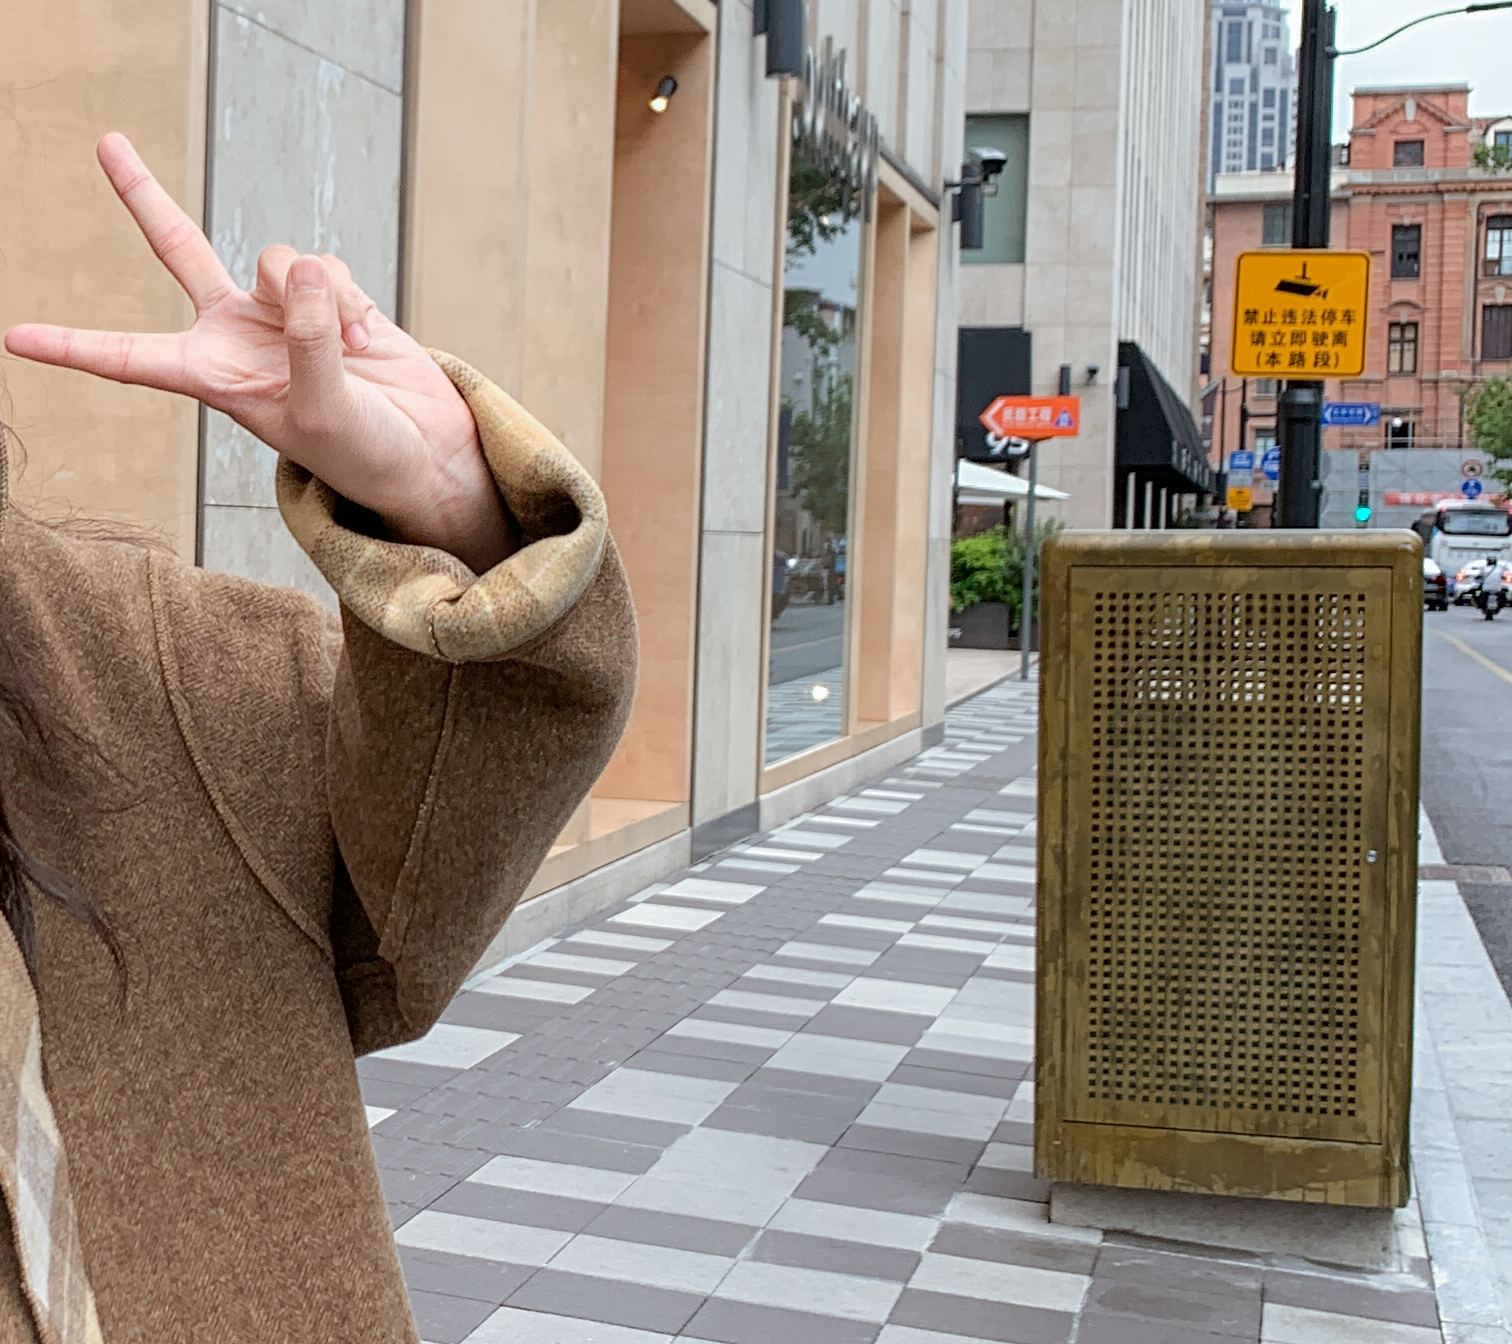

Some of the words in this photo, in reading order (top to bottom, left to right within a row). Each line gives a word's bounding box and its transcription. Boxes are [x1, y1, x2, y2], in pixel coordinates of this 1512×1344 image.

[1244, 308, 1357, 325] 禁止违法停车
[1250, 329, 1348, 347] 请立即驶离
